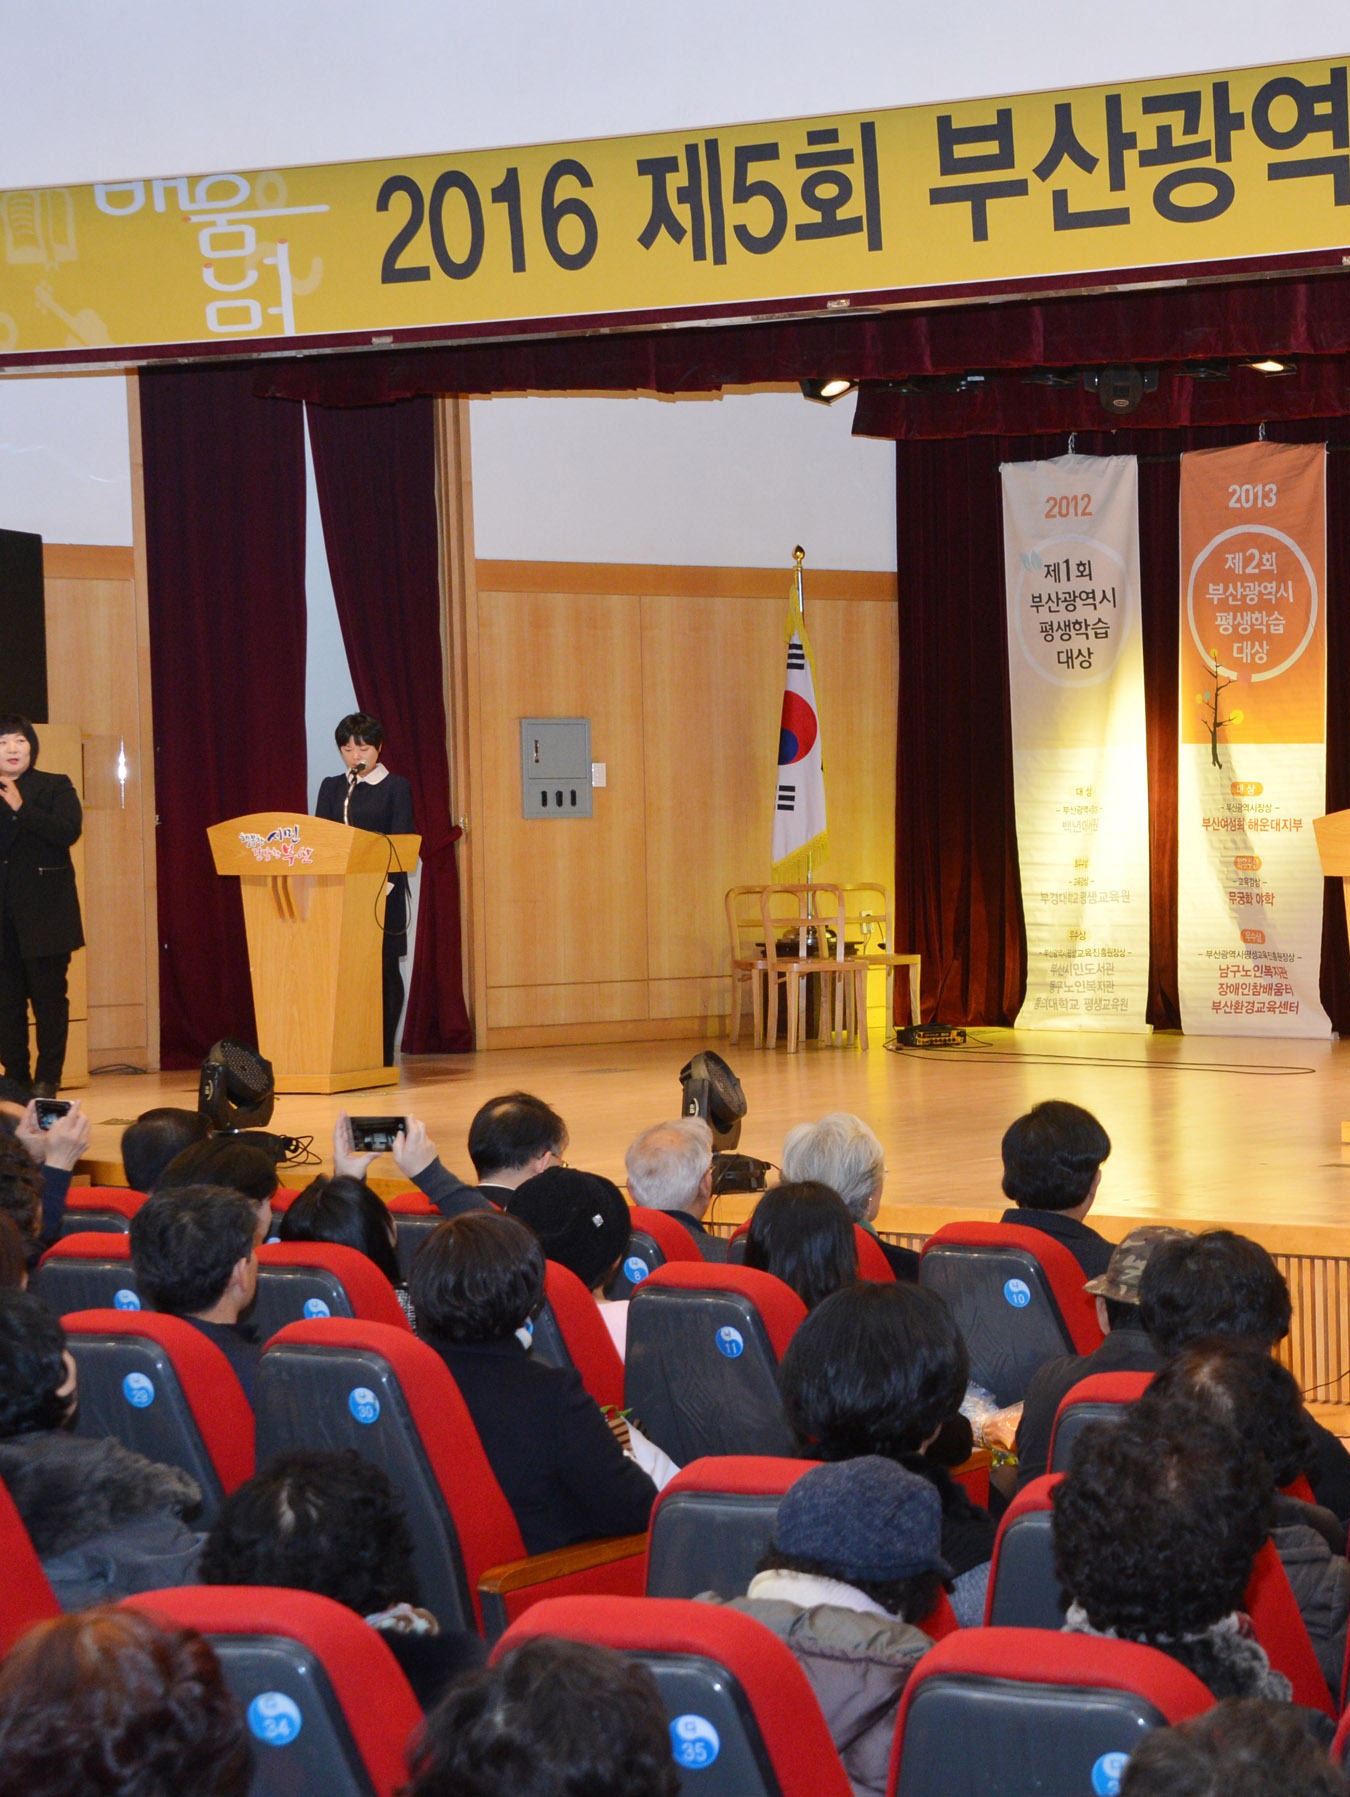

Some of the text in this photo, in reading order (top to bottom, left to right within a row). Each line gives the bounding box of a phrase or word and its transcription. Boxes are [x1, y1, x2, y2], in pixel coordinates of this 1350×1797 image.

[375, 157, 599, 286] 2016
[635, 120, 884, 267] 제5회
[1045, 494, 1093, 518] 2012
[1228, 483, 1277, 508] 2013
[1044, 558, 1092, 583] 제1회
[1224, 548, 1277, 575] 제2회
[1030, 587, 1117, 614] 부산광역시
[1205, 580, 1294, 605] 부산광역시
[1039, 617, 1110, 642] 평생학습
[1215, 611, 1286, 635] 평생학습
[1057, 647, 1094, 669] 대상
[1233, 640, 1270, 664] 대상
[267, 825, 300, 843] 시민
[1248, 818, 1303, 832] 해운대지부
[1218, 964, 1289, 980] 남구노인복지관
[1218, 982, 1294, 997] 장애인참배움터
[1211, 1000, 1300, 1015] 부산환경교육센터
[633, 1270, 640, 1280] 8
[1012, 1294, 1025, 1305] 10
[725, 1342, 738, 1355] 11
[264, 1719, 290, 1736] 34
[682, 1741, 707, 1761] 35
